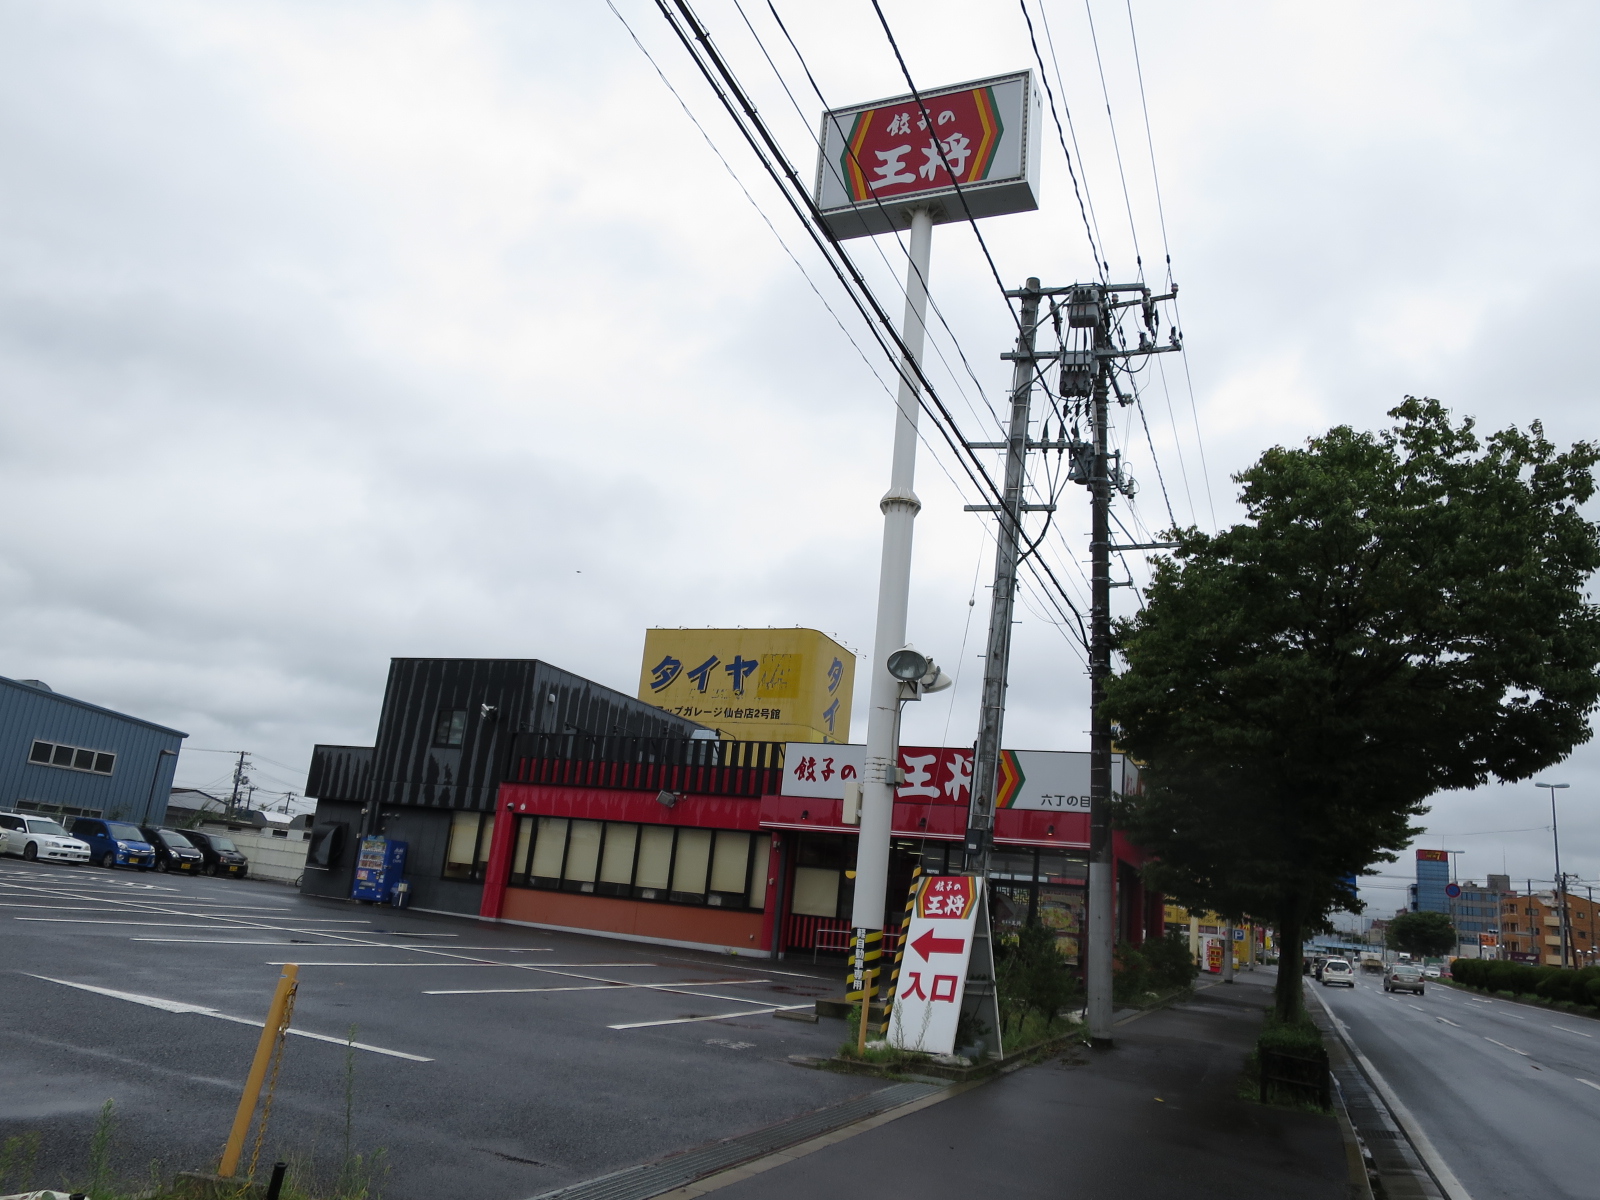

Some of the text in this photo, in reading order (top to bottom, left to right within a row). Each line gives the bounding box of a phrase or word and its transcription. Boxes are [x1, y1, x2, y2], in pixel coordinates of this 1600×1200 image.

[886, 108, 956, 137] 餃子の
[868, 131, 972, 191] 王将
[650, 655, 759, 694] タイヤ
[822, 656, 845, 744] タイ
[793, 755, 858, 783] 餃子の
[1041, 794, 1091, 808] 六丁の目
[934, 881, 962, 892] 餃子の
[925, 895, 965, 916] 王将
[1234, 929, 1243, 940] P
[852, 928, 867, 990] 軽自動車専用
[900, 971, 959, 1003] 入口
